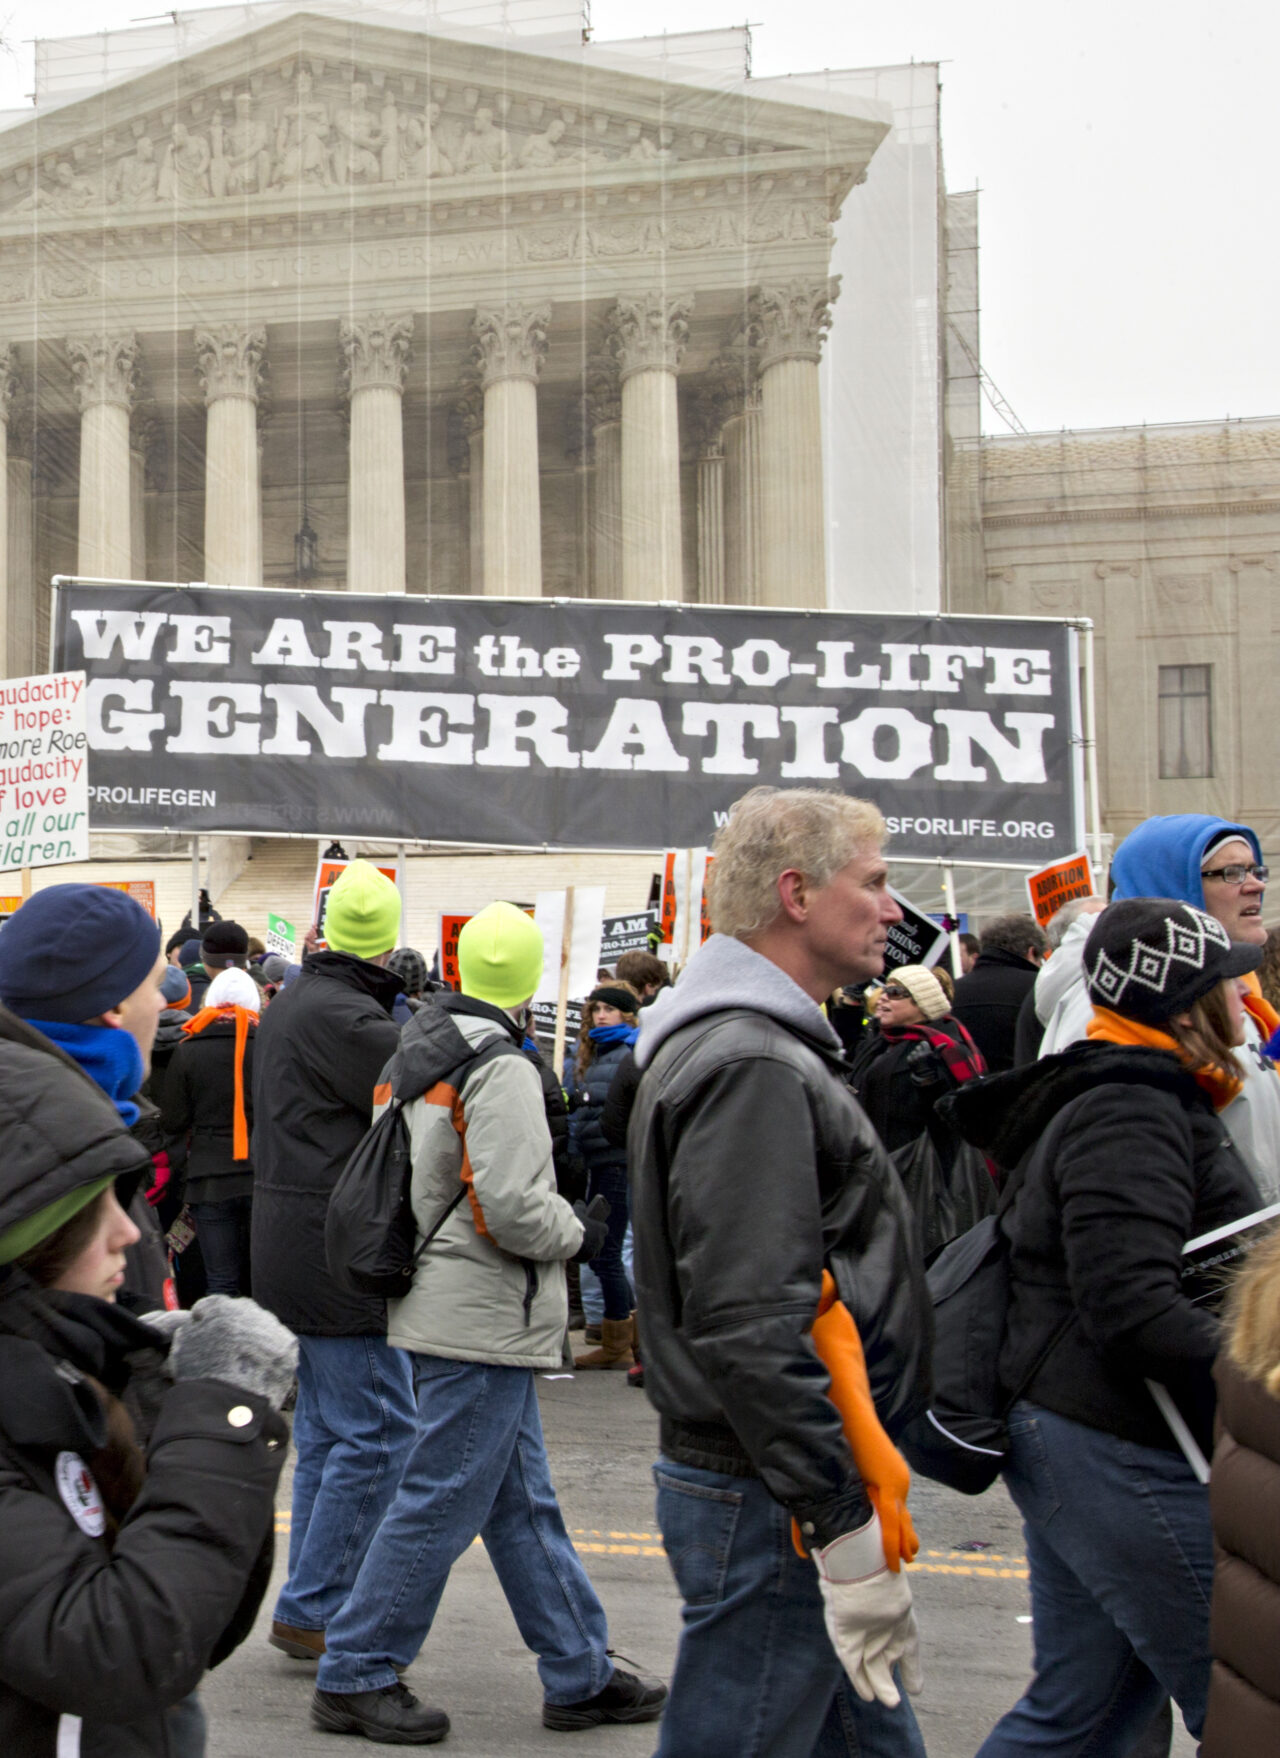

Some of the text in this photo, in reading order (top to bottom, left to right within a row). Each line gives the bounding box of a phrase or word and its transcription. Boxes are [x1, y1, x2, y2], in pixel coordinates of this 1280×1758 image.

[216, 254, 321, 283] JUSTICE
[336, 246, 426, 273] UNDER
[440, 242, 494, 264] LAW
[71, 609, 1053, 696] WE ARE the PRO-LIFE
[14, 708, 72, 732] hope:
[86, 678, 1055, 784] GENERATION
[47, 730, 87, 754] Roe
[15, 787, 67, 810] love
[5, 812, 37, 837] all
[43, 811, 86, 833] our
[1037, 865, 1084, 898] ABORTION
[609, 917, 648, 936] AM
